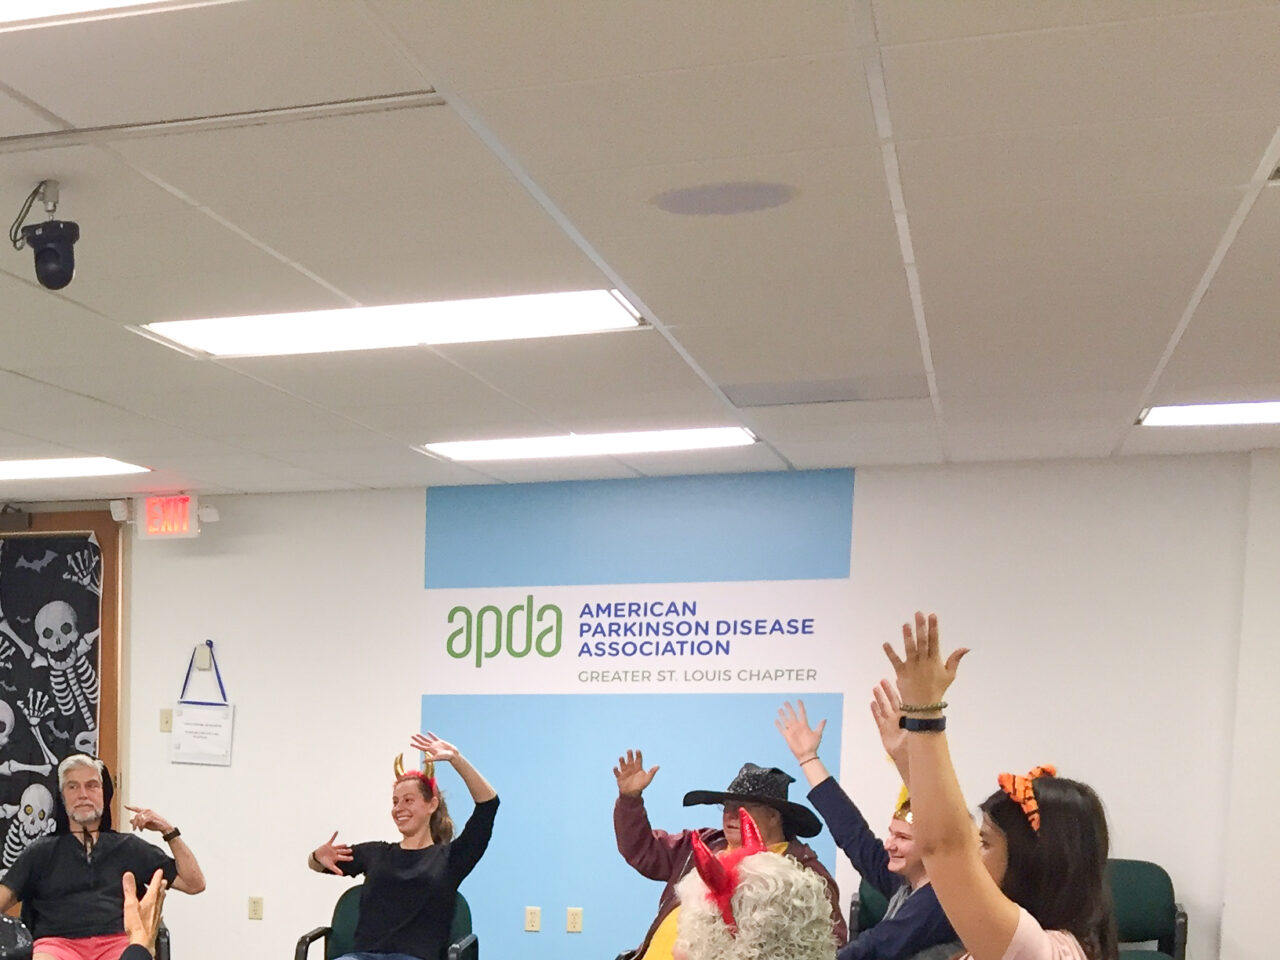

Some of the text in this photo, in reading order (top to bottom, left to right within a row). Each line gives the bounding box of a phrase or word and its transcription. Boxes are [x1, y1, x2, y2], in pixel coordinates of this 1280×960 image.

[145, 496, 190, 534] EXIT
[579, 600, 697, 618] AMERICAN
[446, 594, 563, 668] apda
[579, 618, 815, 638] PARKINSON DISEASE
[578, 640, 730, 657] ASSOCIATION
[578, 668, 817, 683] GREATER ST. LOUIS CHAPTER
